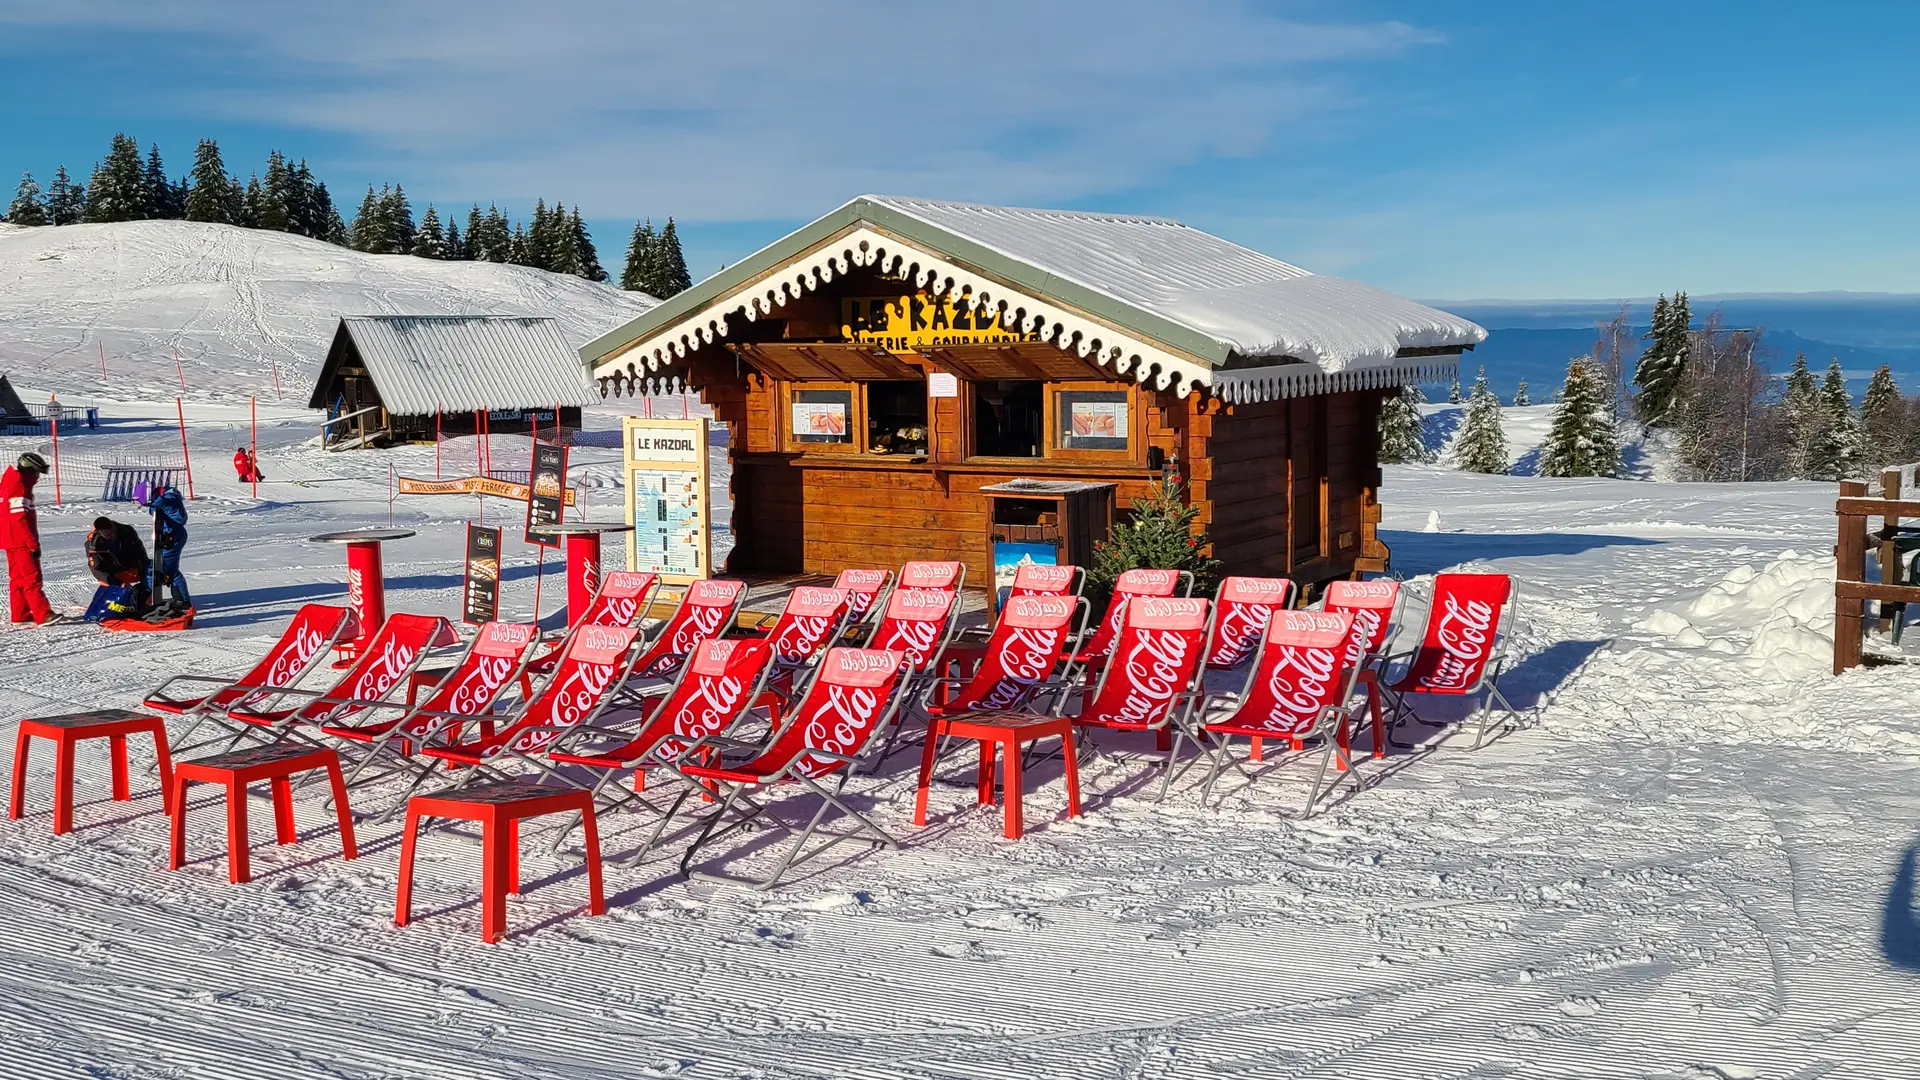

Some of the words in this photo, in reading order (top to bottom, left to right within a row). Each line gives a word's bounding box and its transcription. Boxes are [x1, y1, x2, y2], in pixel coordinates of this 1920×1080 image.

[909, 297, 1006, 332] KAZD
[638, 438, 651, 450] LE
[653, 438, 695, 451] KAZDAL
[481, 481, 512, 495] FERMÉE
